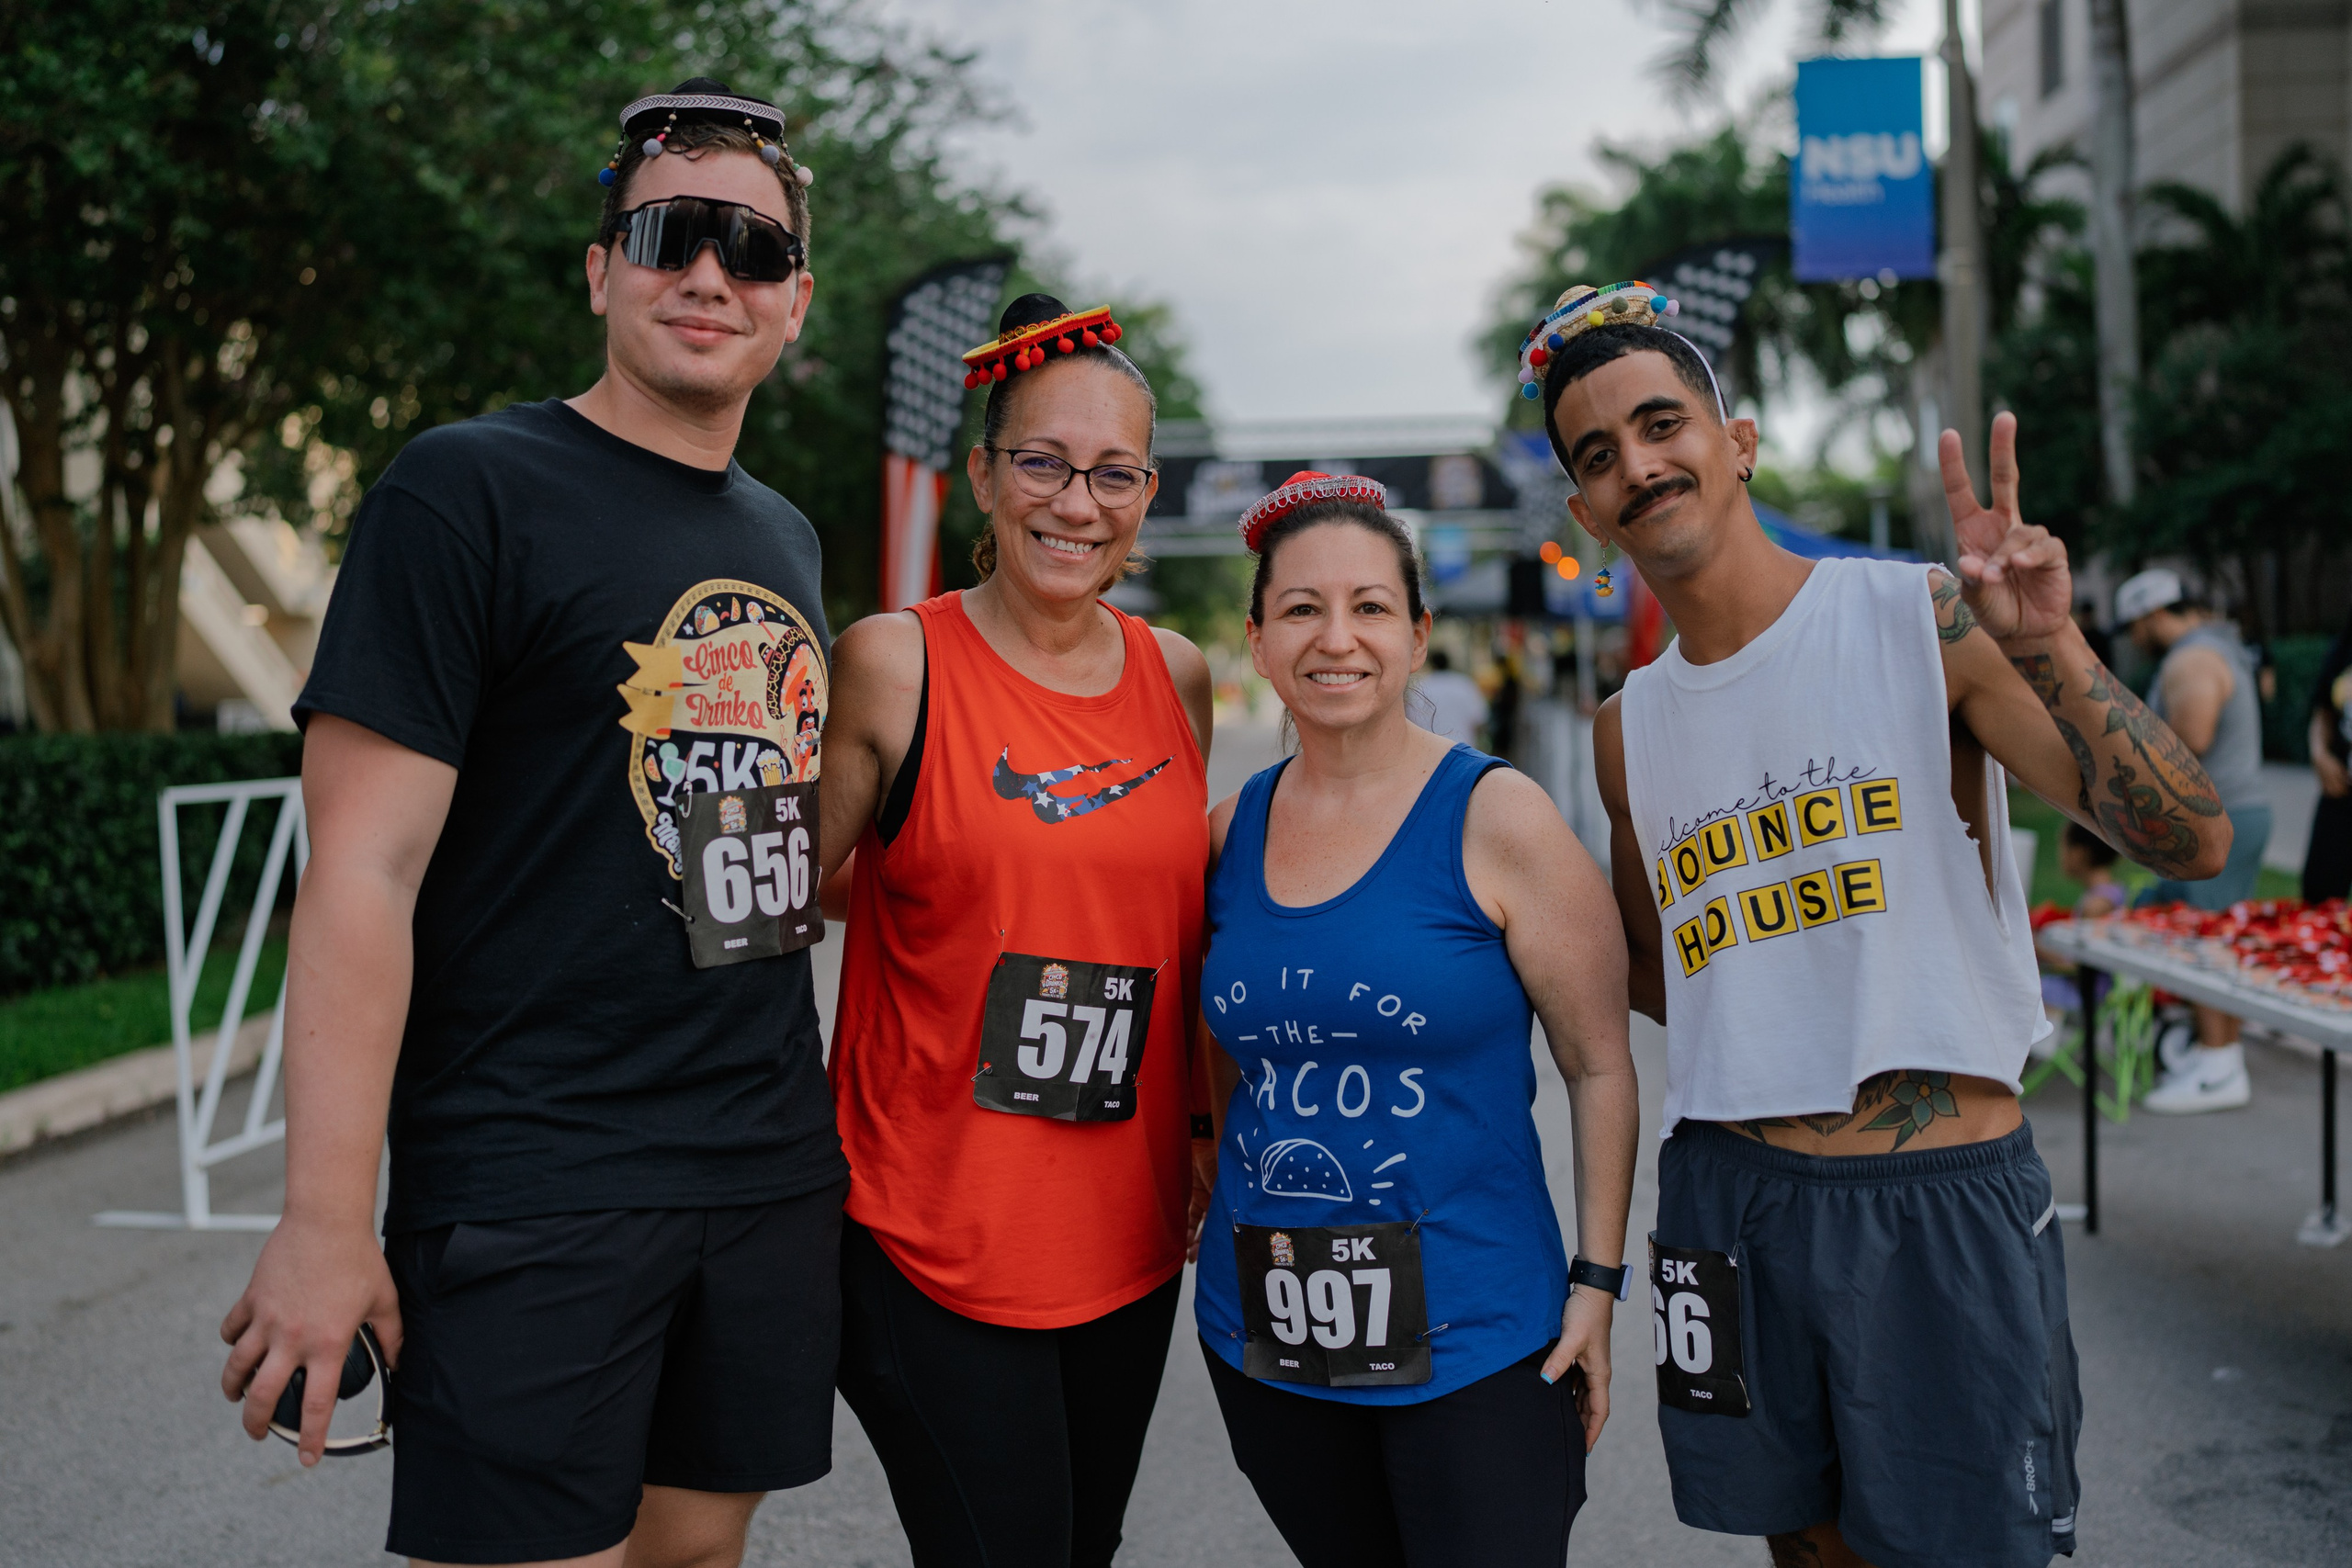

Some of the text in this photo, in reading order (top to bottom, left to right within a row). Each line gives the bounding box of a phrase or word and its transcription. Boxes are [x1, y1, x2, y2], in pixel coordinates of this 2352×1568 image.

[1802, 132, 1921, 180] NSU
[684, 640, 757, 680] Cinco
[718, 672, 734, 692] de
[685, 690, 767, 729] Drinko
[687, 740, 759, 793] 5K
[775, 795, 801, 822] 5K
[1657, 756, 1877, 855] elcome to the
[702, 827, 810, 924] 656
[795, 924, 808, 934] TACO
[1679, 866, 1877, 969] HOUSE
[724, 937, 749, 950] BEER
[1104, 976, 1135, 1001] 5K
[1214, 966, 1427, 1035] DO IT FOR
[1017, 998, 1134, 1085] 574
[1265, 1020, 1324, 1044] THE
[1013, 1091, 1040, 1102] BEER
[1242, 1057, 1425, 1118] ACOS
[1104, 1100, 1121, 1109] TACO
[1332, 1236, 1377, 1262] 5K
[1661, 1258, 1700, 1285] 5K
[1264, 1268, 1392, 1349] 997
[1279, 1358, 1300, 1369] BEER
[1369, 1362, 1396, 1371] TACO
[1690, 1388, 1713, 1400] TACO
[2023, 1439, 2036, 1493] BROOKS
